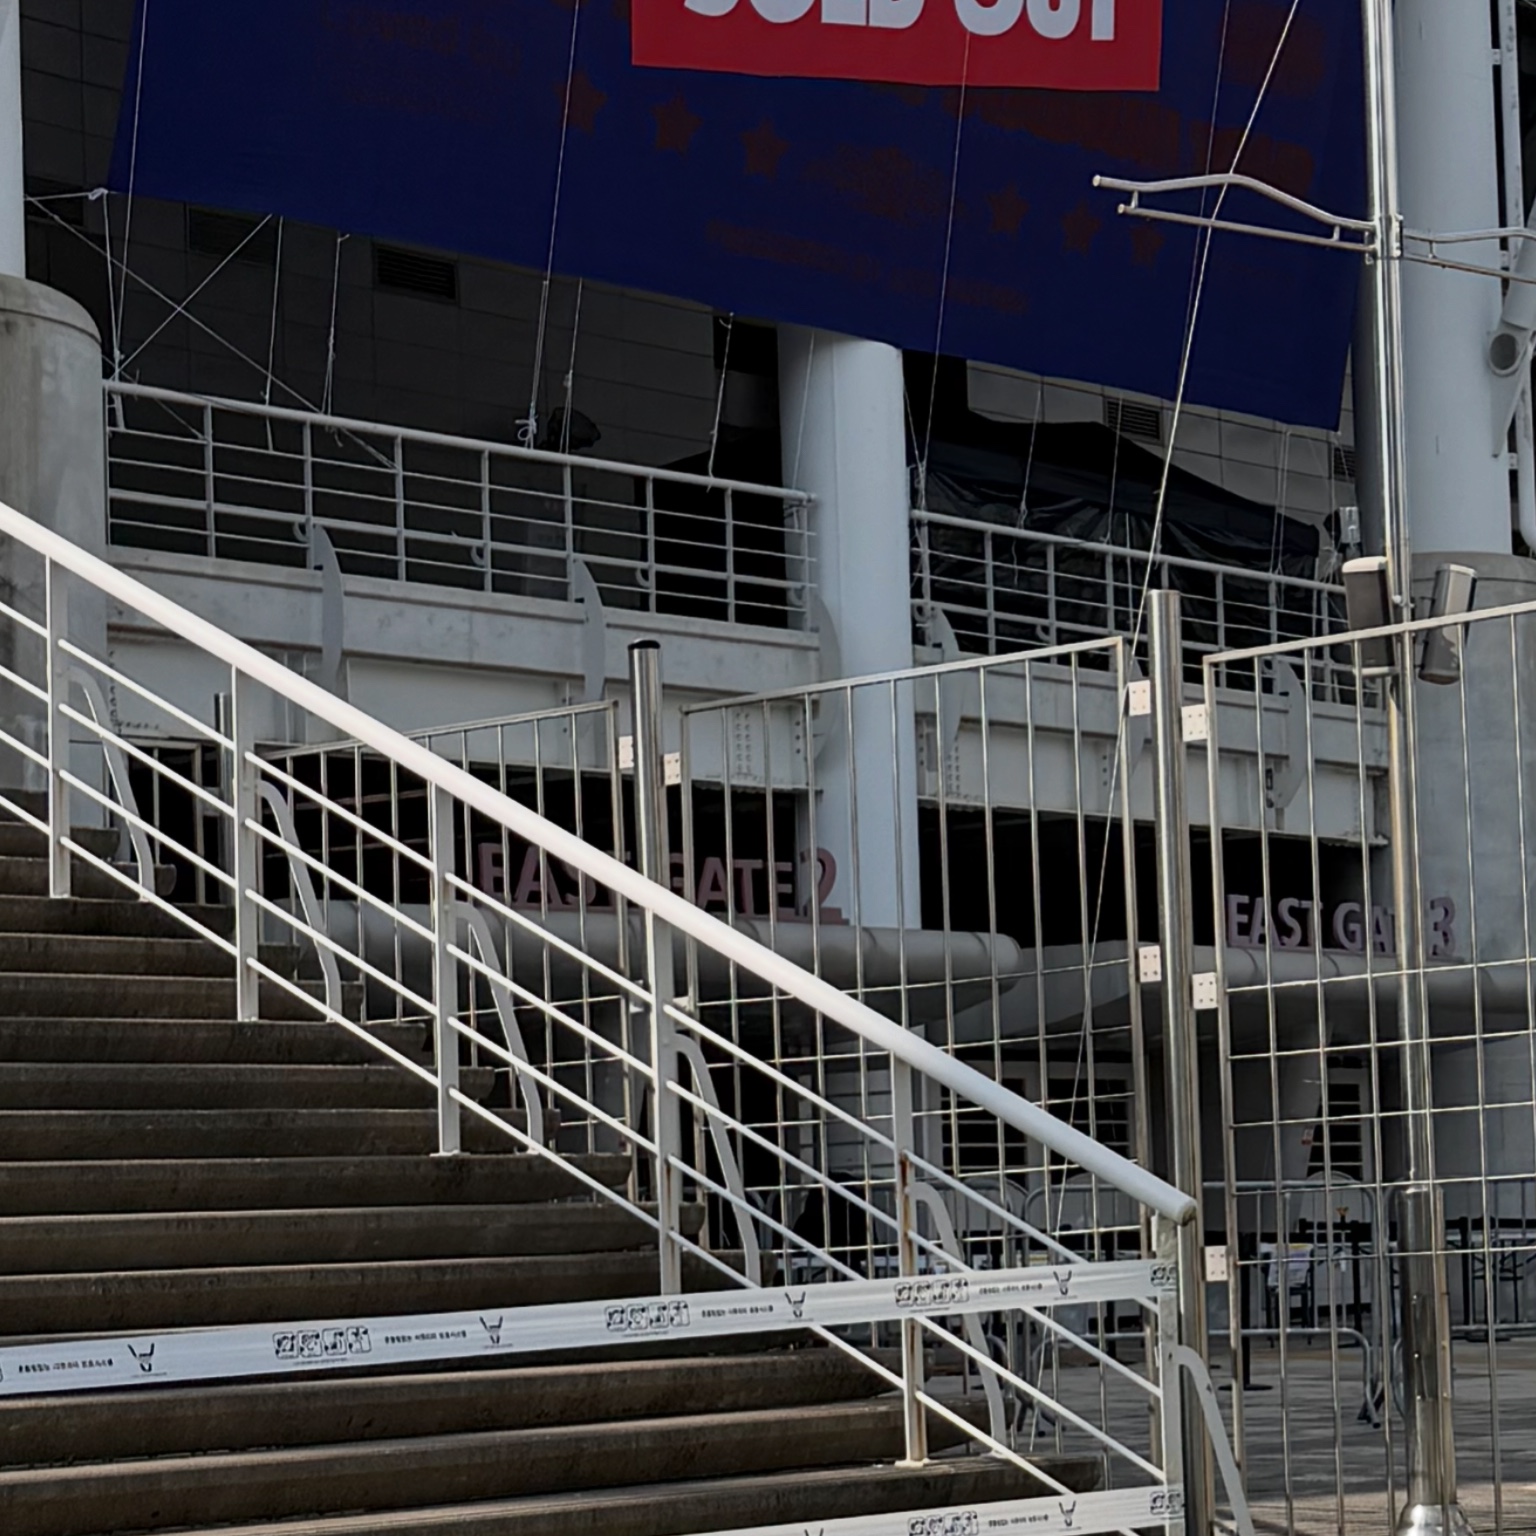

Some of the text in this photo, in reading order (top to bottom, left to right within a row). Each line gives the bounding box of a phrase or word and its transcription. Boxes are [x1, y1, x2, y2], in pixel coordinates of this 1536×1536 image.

[797, 846, 842, 919] 2
[1226, 893, 1324, 948] EAST
[1429, 896, 1457, 957] 3
